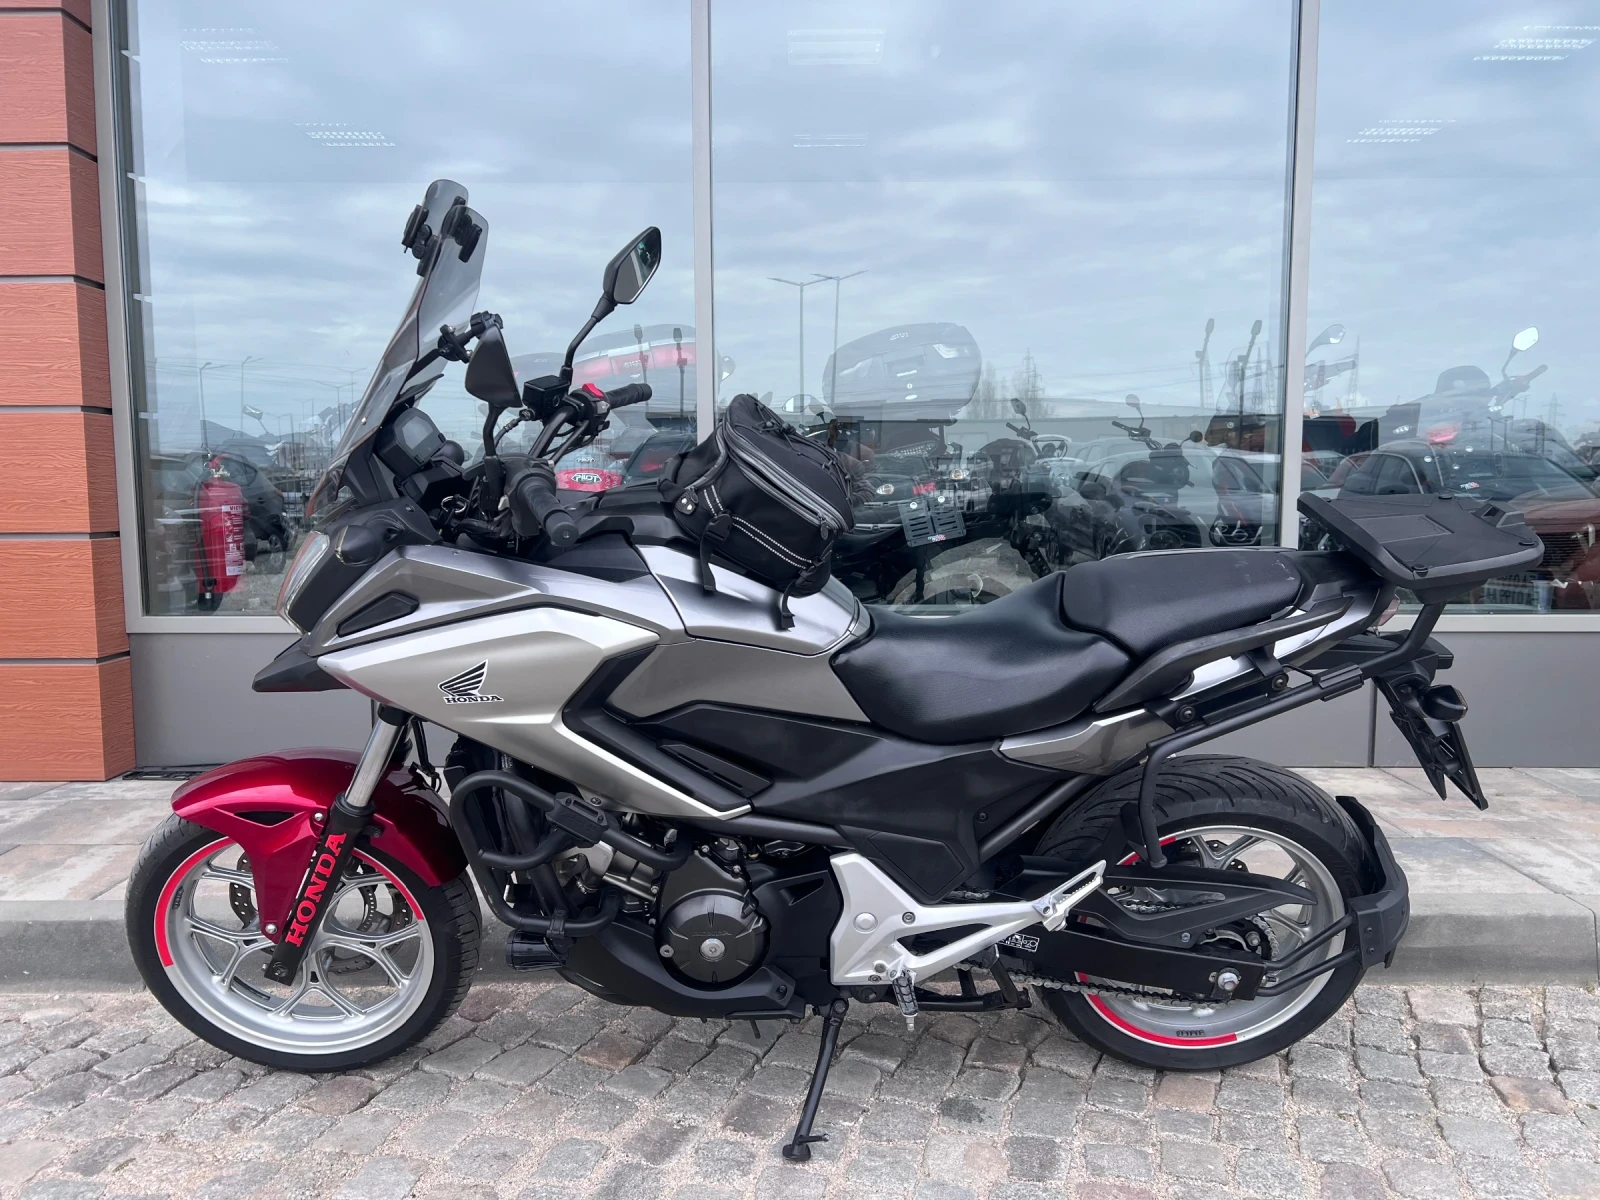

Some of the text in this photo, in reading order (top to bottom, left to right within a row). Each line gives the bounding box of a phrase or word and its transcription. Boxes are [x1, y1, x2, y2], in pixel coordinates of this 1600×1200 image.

[575, 474, 598, 483] PILOT
[444, 695, 503, 704] HONDA
[285, 833, 347, 947] HONDA
